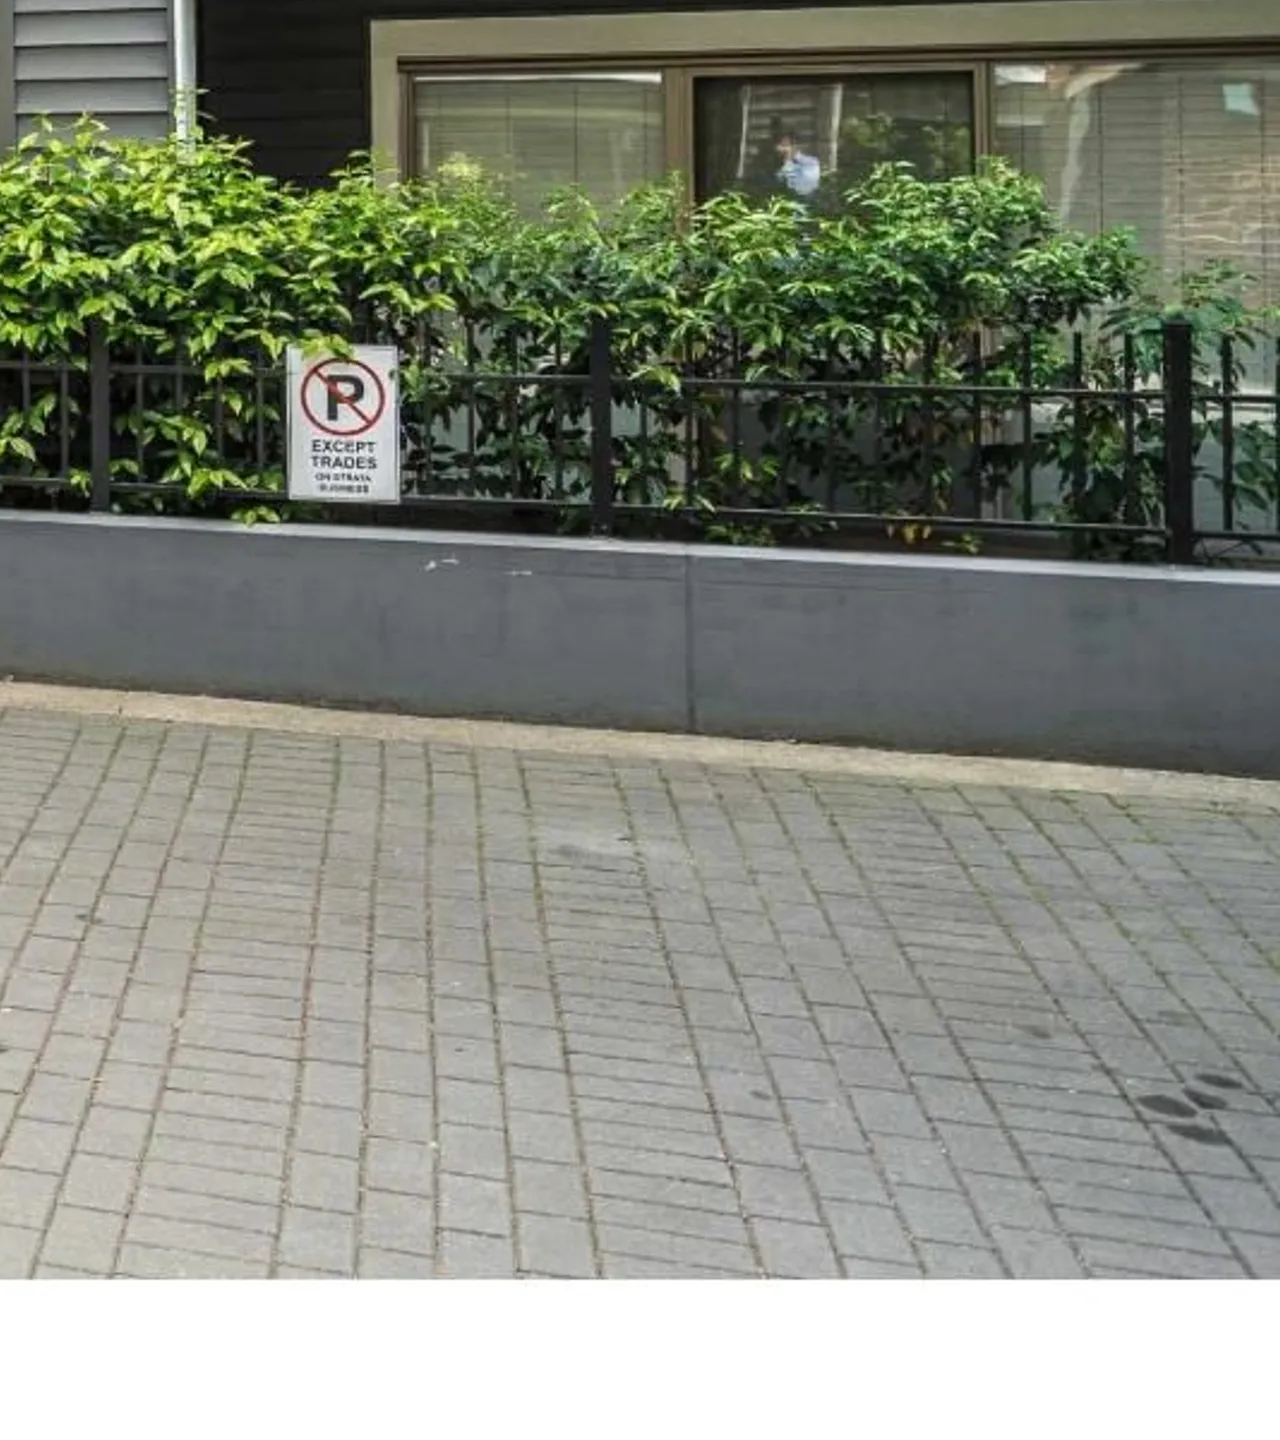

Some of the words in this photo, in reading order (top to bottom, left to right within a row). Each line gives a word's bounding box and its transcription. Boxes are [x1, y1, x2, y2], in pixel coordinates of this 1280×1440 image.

[327, 374, 364, 421] P
[312, 439, 377, 453] EXCEPT
[311, 455, 377, 469] TRADES
